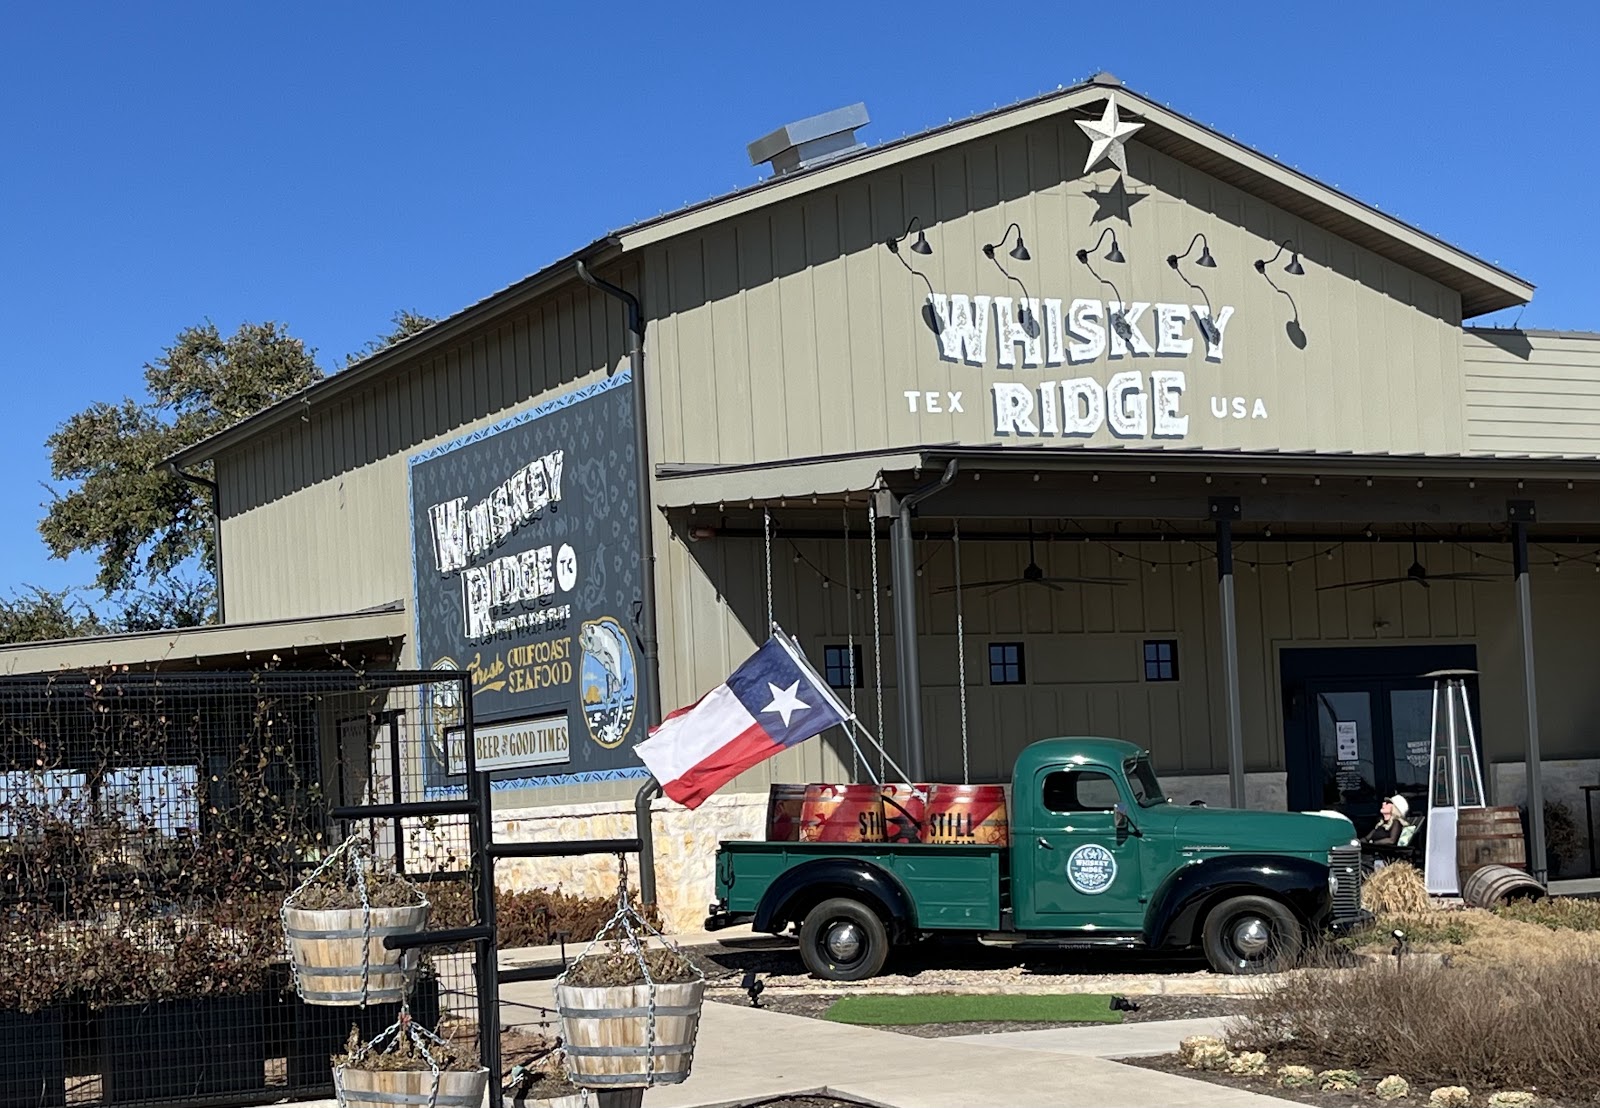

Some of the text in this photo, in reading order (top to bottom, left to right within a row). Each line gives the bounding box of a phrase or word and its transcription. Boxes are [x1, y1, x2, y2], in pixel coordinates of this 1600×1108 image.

[925, 293, 1235, 369] WHISKEY
[903, 391, 965, 413] TEX
[990, 370, 1190, 440] RIDGE
[1210, 396, 1268, 419] USA
[508, 661, 572, 693] SEAFOOD
[476, 735, 500, 760] BEER
[509, 731, 536, 756] GOOD
[537, 726, 568, 753] TIMES
[929, 812, 974, 837] STILL
